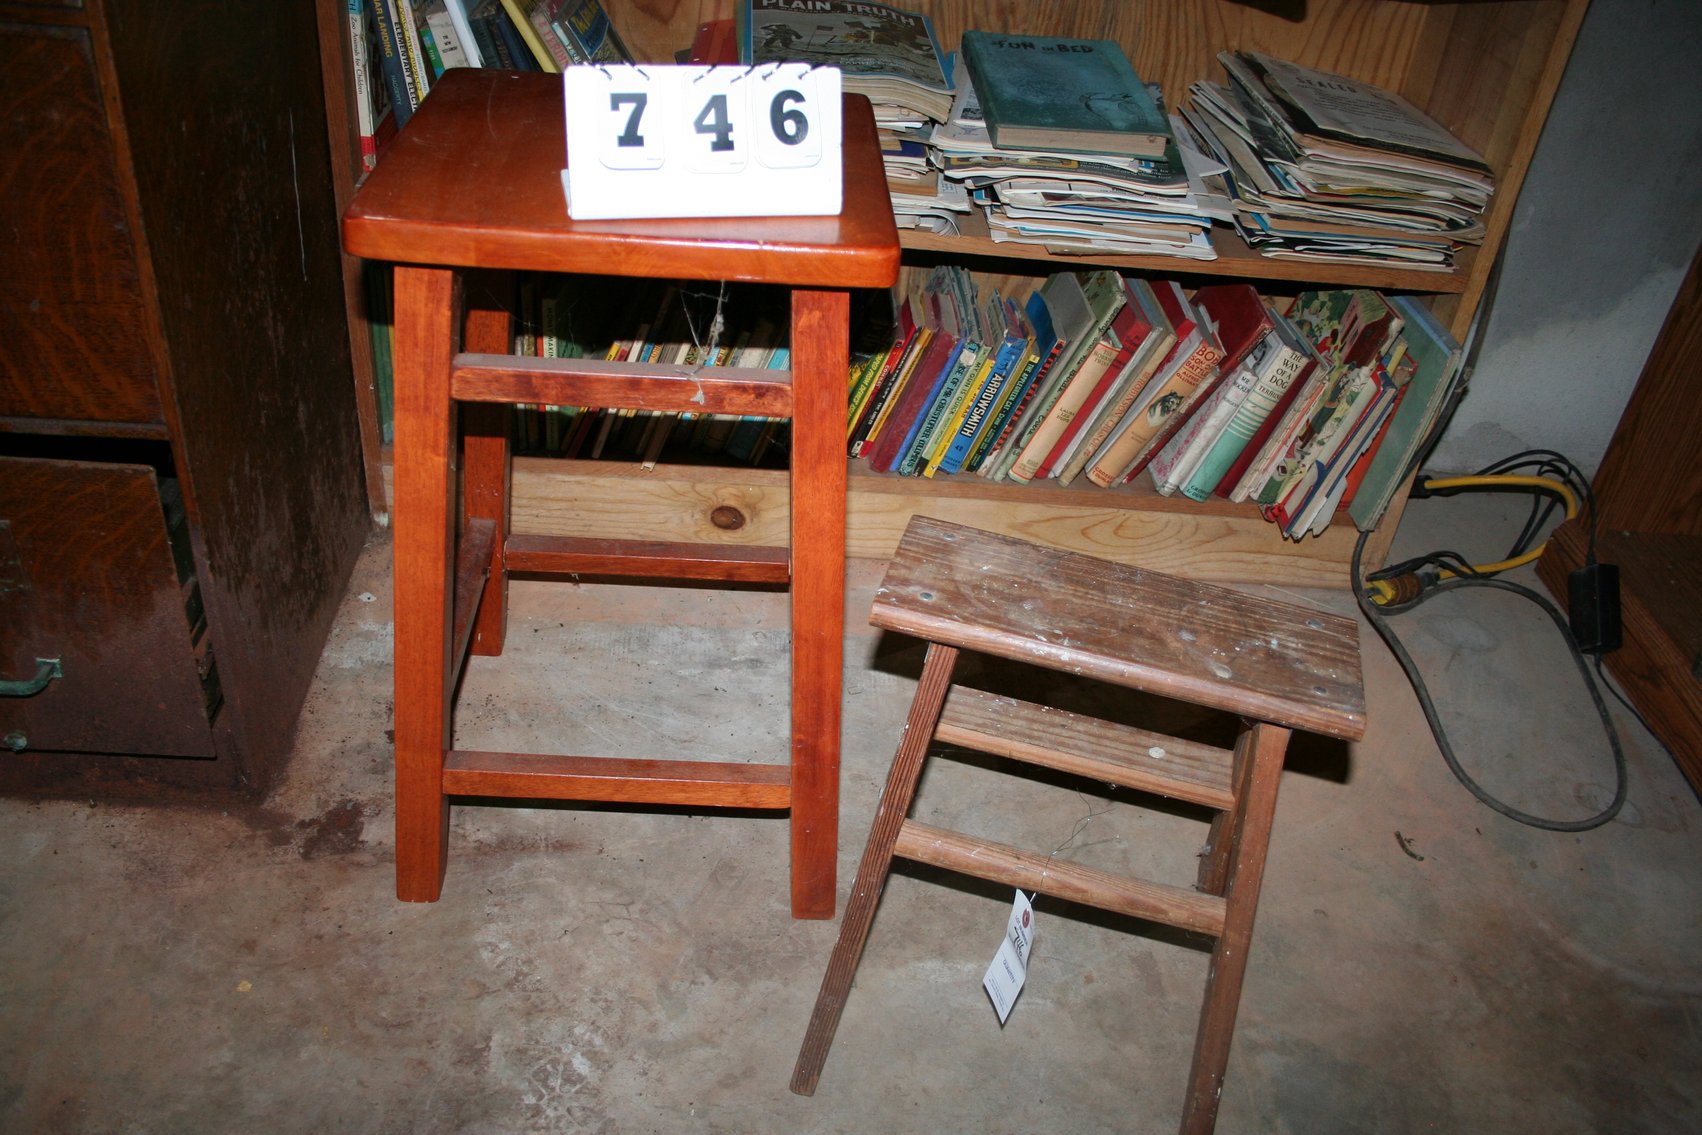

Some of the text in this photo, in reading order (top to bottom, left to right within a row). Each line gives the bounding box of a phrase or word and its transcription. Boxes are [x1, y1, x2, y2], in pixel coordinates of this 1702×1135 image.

[762, 0, 916, 26] PLAIN TRUTH
[378, 16, 393, 58] LANDING
[393, 21, 412, 79] ELEMENTARY
[1056, 44, 1094, 53] BED
[1195, 345, 1222, 366] BOB
[1282, 358, 1301, 372] WAY
[1290, 352, 1303, 363] THE
[1024, 363, 1035, 374] THE
[1185, 360, 1209, 377] BATTLE
[1276, 368, 1288, 378] OF
[948, 361, 982, 416] MY GUN IS QUICK
[1269, 375, 1289, 390] DOG
[961, 374, 1005, 438] ARROWSMITH
[1115, 375, 1148, 418] ROBINSON
